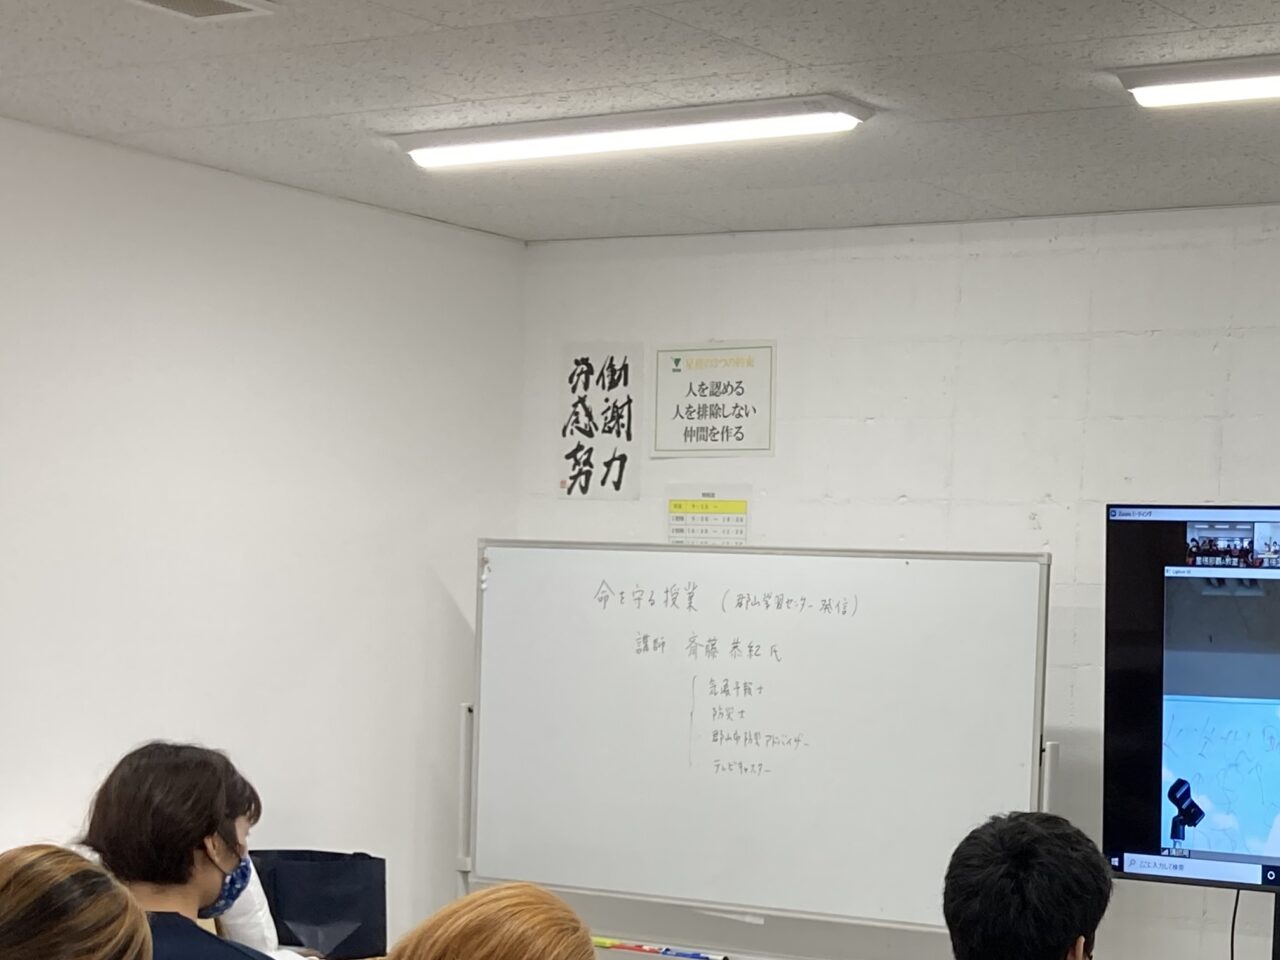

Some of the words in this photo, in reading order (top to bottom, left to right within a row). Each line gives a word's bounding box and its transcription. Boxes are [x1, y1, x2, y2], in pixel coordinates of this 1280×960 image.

[568, 356, 630, 394] 労働
[685, 380, 745, 398] 人を認める
[561, 394, 633, 441] 感謝
[672, 403, 757, 421] 人を排除しない
[684, 426, 745, 443] 仲間を作る
[564, 441, 628, 495] 努力
[593, 578, 699, 612] 命を守る授業
[635, 631, 667, 654] 講師
